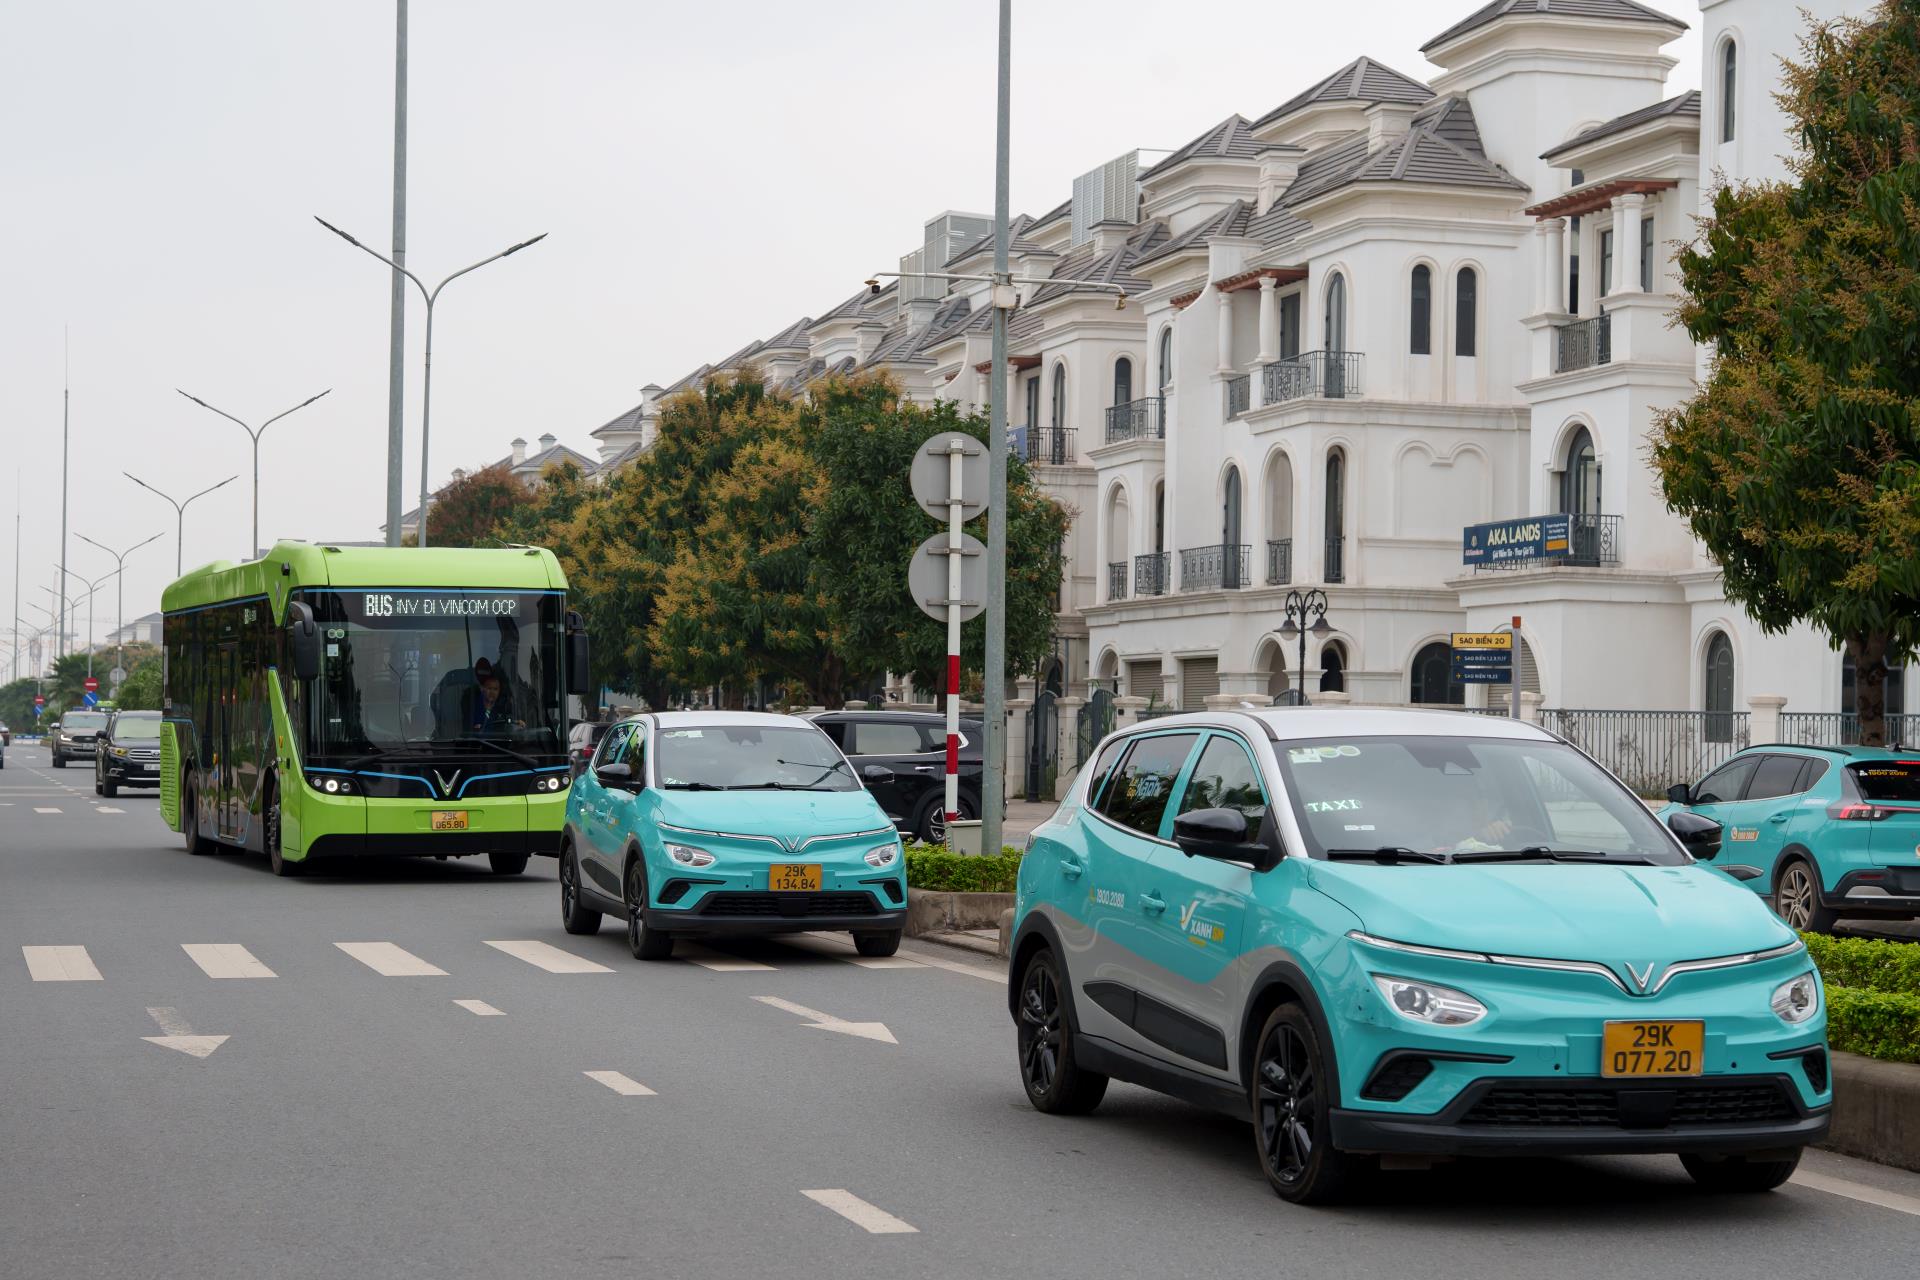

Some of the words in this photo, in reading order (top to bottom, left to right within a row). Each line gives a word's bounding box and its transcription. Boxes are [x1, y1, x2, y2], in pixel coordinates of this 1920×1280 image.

[1487, 527, 1508, 546] AKA
[1509, 523, 1541, 544] LANDS
[366, 594, 393, 617] BUS
[424, 599, 435, 615] ĐI
[439, 599, 488, 615] VINCOM
[492, 599, 516, 615] OCP
[1307, 799, 1361, 812] TAXI
[442, 812, 458, 820] 29K
[435, 820, 465, 829] 065.80
[784, 865, 807, 877] 29K
[776, 878, 816, 890] 134.84
[1190, 919, 1212, 939] XANH
[1632, 1024, 1675, 1048] 29K
[1613, 1050, 1692, 1073] 077.20
